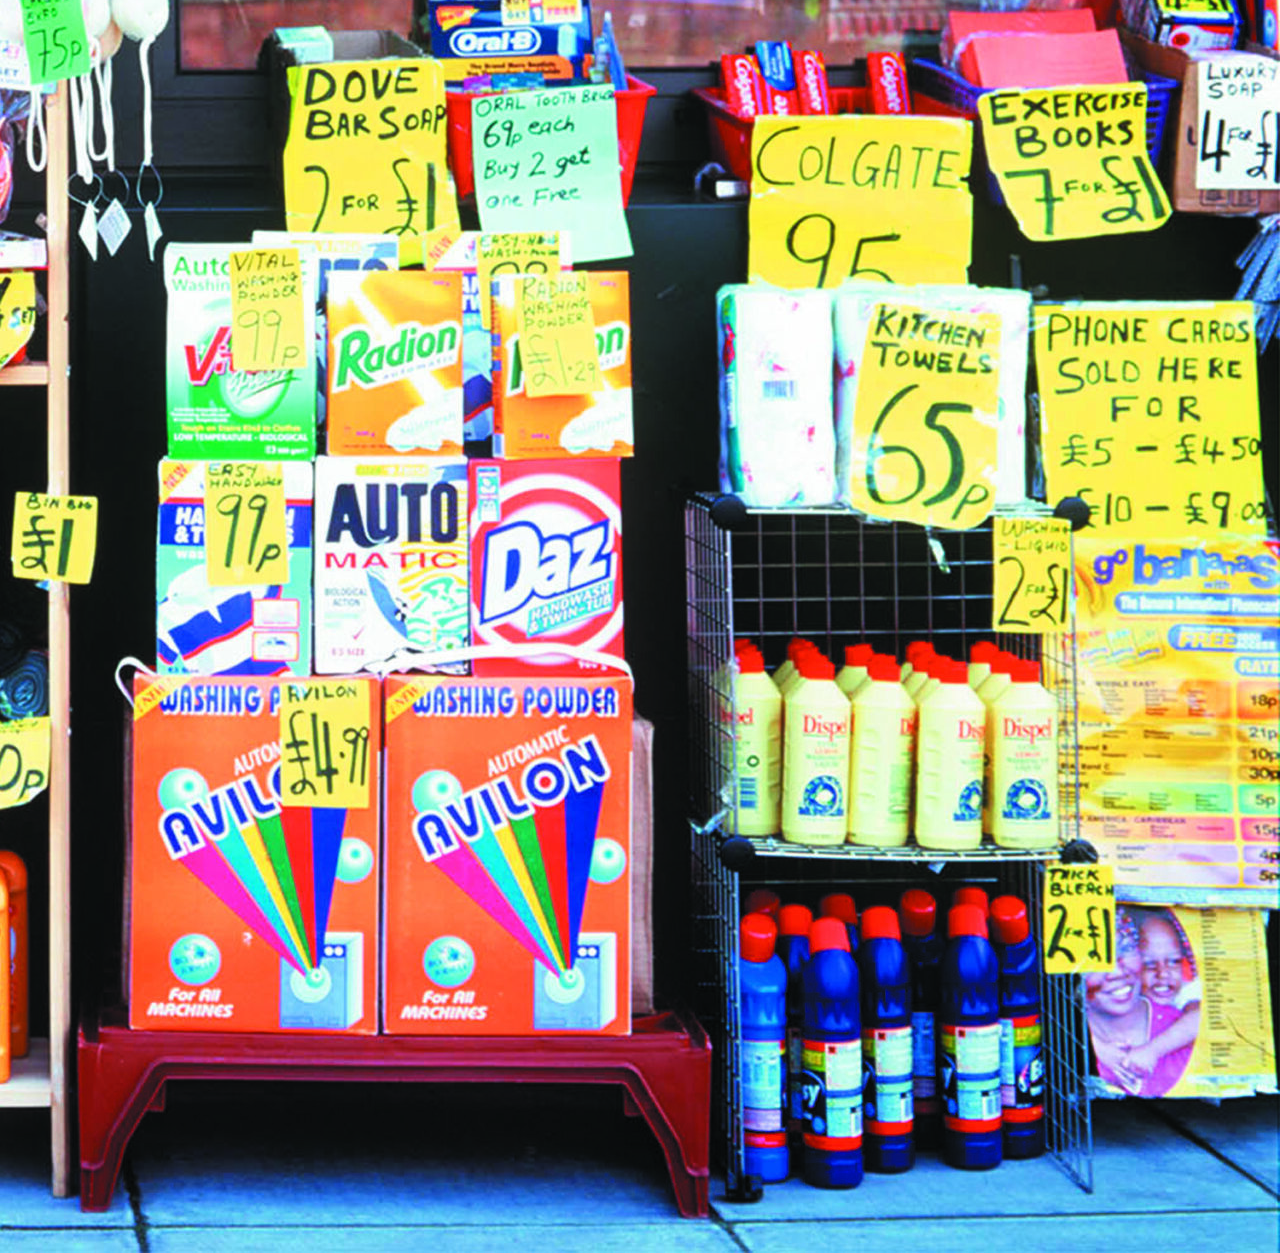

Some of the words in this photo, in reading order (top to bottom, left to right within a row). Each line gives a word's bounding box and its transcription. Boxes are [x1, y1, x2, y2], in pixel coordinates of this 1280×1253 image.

[29, 26, 82, 77] 75p
[456, 31, 535, 52] Oral-B
[304, 66, 420, 106] DOVE
[804, 55, 822, 111] Colgate
[881, 55, 901, 113] Colgate
[1208, 83, 1263, 99] SOAP
[475, 96, 526, 118] ORAL
[533, 90, 577, 108] TOOTH
[989, 92, 1148, 126] EXERCISE
[305, 110, 371, 140] BAR
[378, 104, 447, 140] SOAP
[483, 119, 524, 148] 69p
[527, 115, 575, 135] each
[1015, 120, 1134, 158] BOOKS
[756, 125, 961, 191] COLGATE
[1200, 110, 1230, 173] 4
[483, 159, 520, 180] Buy
[528, 151, 546, 177] 2
[553, 144, 592, 179] get
[341, 194, 380, 217] FOR
[383, 157, 436, 236] £1
[485, 195, 523, 209] one
[533, 187, 582, 207] Free
[1004, 168, 1064, 236] 7
[1064, 179, 1107, 195] FOR
[1100, 154, 1166, 224] £1
[234, 252, 295, 272] VITAL
[428, 235, 453, 261] NEW
[523, 277, 587, 300] RADION
[523, 299, 590, 316] WASHING
[523, 314, 585, 331] POWDER
[237, 309, 300, 367] 99p
[874, 304, 986, 348] KITCHEN
[1048, 313, 1148, 352] PHONE
[1167, 317, 1251, 344] CARDS
[336, 324, 458, 388] Radion
[526, 333, 597, 388] £1.29
[871, 341, 993, 374] TOWELS
[1055, 356, 1141, 395] SOLD
[1157, 356, 1243, 383] HERE
[1110, 395, 1202, 423] FOR
[865, 383, 990, 521] 65p
[1060, 434, 1114, 468] £5
[163, 464, 189, 490] NEW
[208, 463, 259, 478] EASY
[26, 492, 60, 510] BIN
[326, 481, 459, 549] AUTO
[1184, 491, 1266, 529] £9.00
[20, 514, 74, 577] £1
[216, 493, 282, 573] 99p
[325, 552, 458, 569] MATIC
[480, 518, 611, 625] Daz
[1093, 549, 1129, 585] go
[1133, 544, 1280, 589] bananas
[531, 580, 610, 621] HANDWASH
[999, 555, 1031, 626] 2
[1029, 562, 1068, 626] £1
[1177, 631, 1238, 648] FREE
[159, 684, 263, 716] WASHING
[288, 684, 358, 703] AVILON
[412, 685, 516, 717] WASHING
[523, 685, 619, 717] POWDER
[1249, 694, 1278, 709] 18p
[803, 714, 848, 742] Dispel
[1002, 716, 1053, 745] Dispel
[1248, 726, 1278, 742] 21p
[286, 709, 370, 796] £4.99
[486, 724, 571, 778] AUTOMATIC
[412, 733, 612, 863] AVILON
[1255, 794, 1276, 808] 5p
[1050, 881, 1114, 897] BLEACH
[1046, 903, 1076, 964] 2
[1086, 905, 1112, 964] £1
[147, 1003, 234, 1018] MACHINES
[169, 988, 197, 1001] For
[199, 987, 221, 1001] All
[422, 990, 450, 1004] For
[452, 990, 475, 1004] All
[400, 1006, 488, 1021] MACHINES
